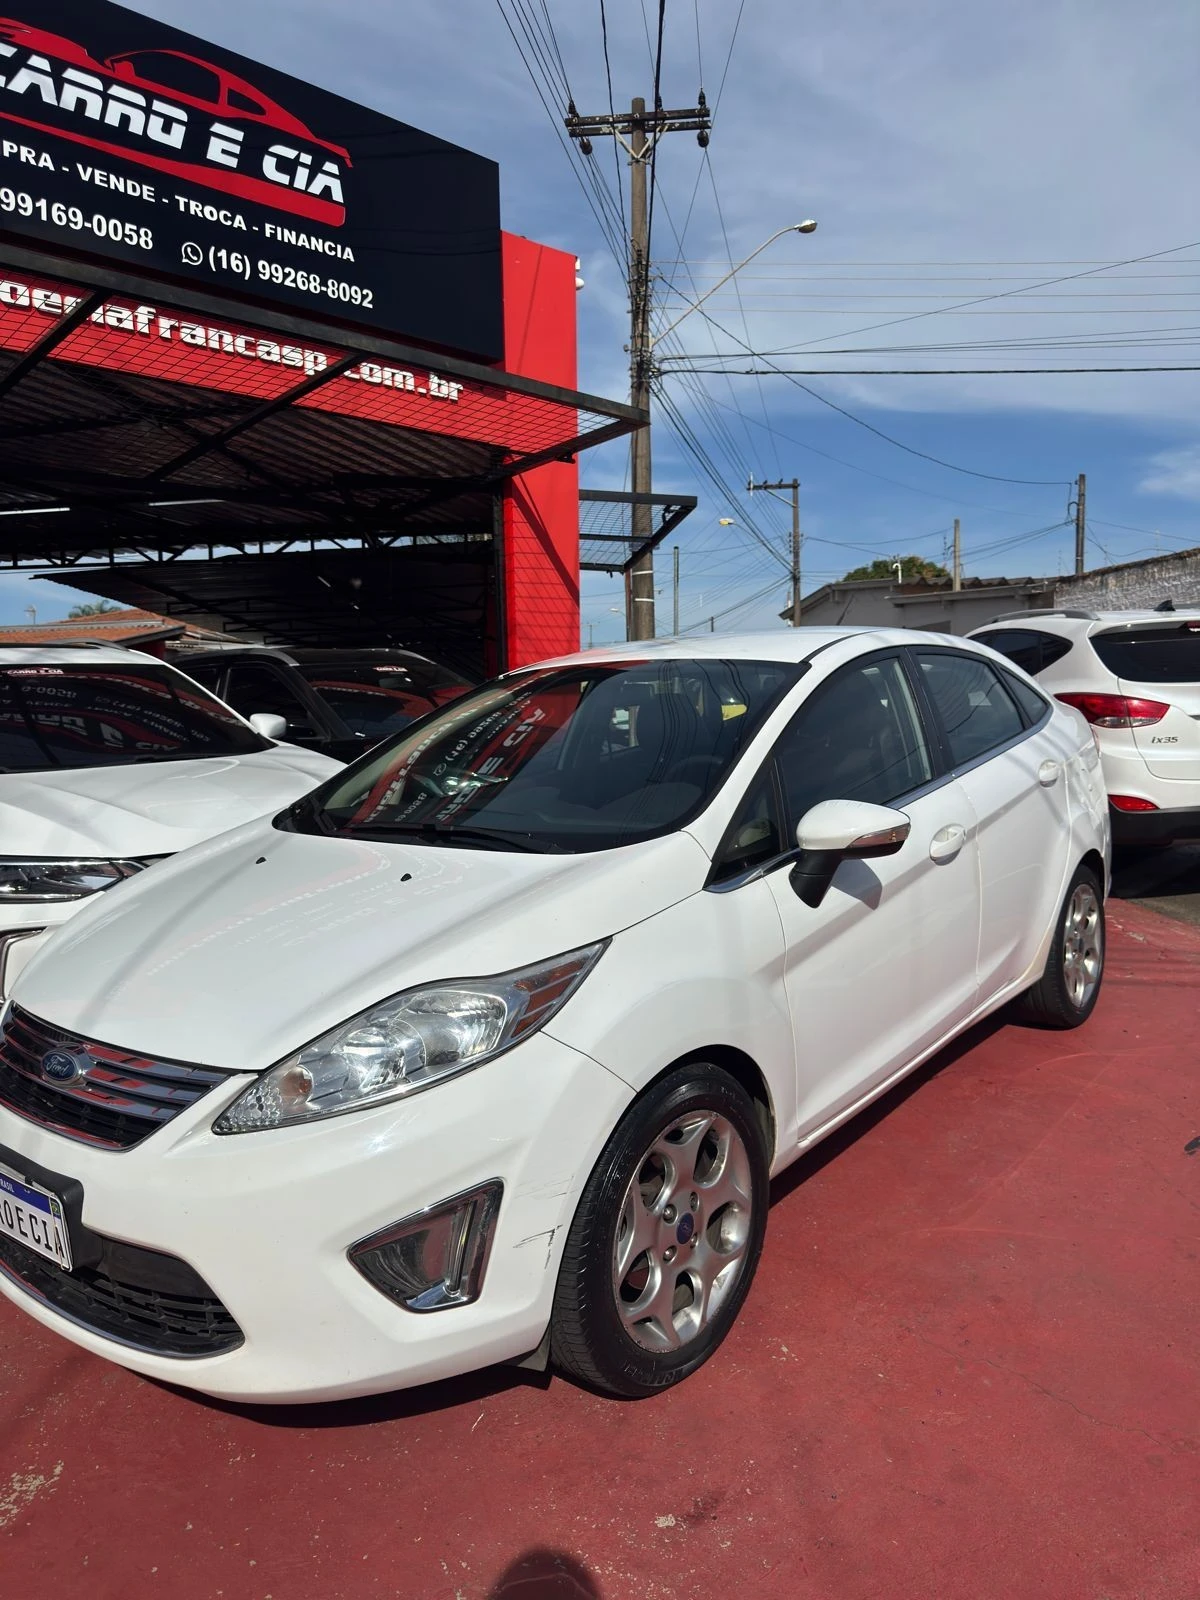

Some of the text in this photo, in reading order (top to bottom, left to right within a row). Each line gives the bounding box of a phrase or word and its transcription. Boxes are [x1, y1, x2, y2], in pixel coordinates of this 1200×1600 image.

[206, 122, 245, 169] E
[262, 144, 344, 204] CIA
[0, 187, 154, 250] 99169-0058
[76, 162, 155, 203] VENDE
[174, 195, 247, 231] TROCA
[264, 223, 355, 262] FINANCIA
[208, 246, 374, 309] (16) 99268-8092
[1151, 736, 1178, 744] ix35
[46, 1055, 70, 1077] Ford
